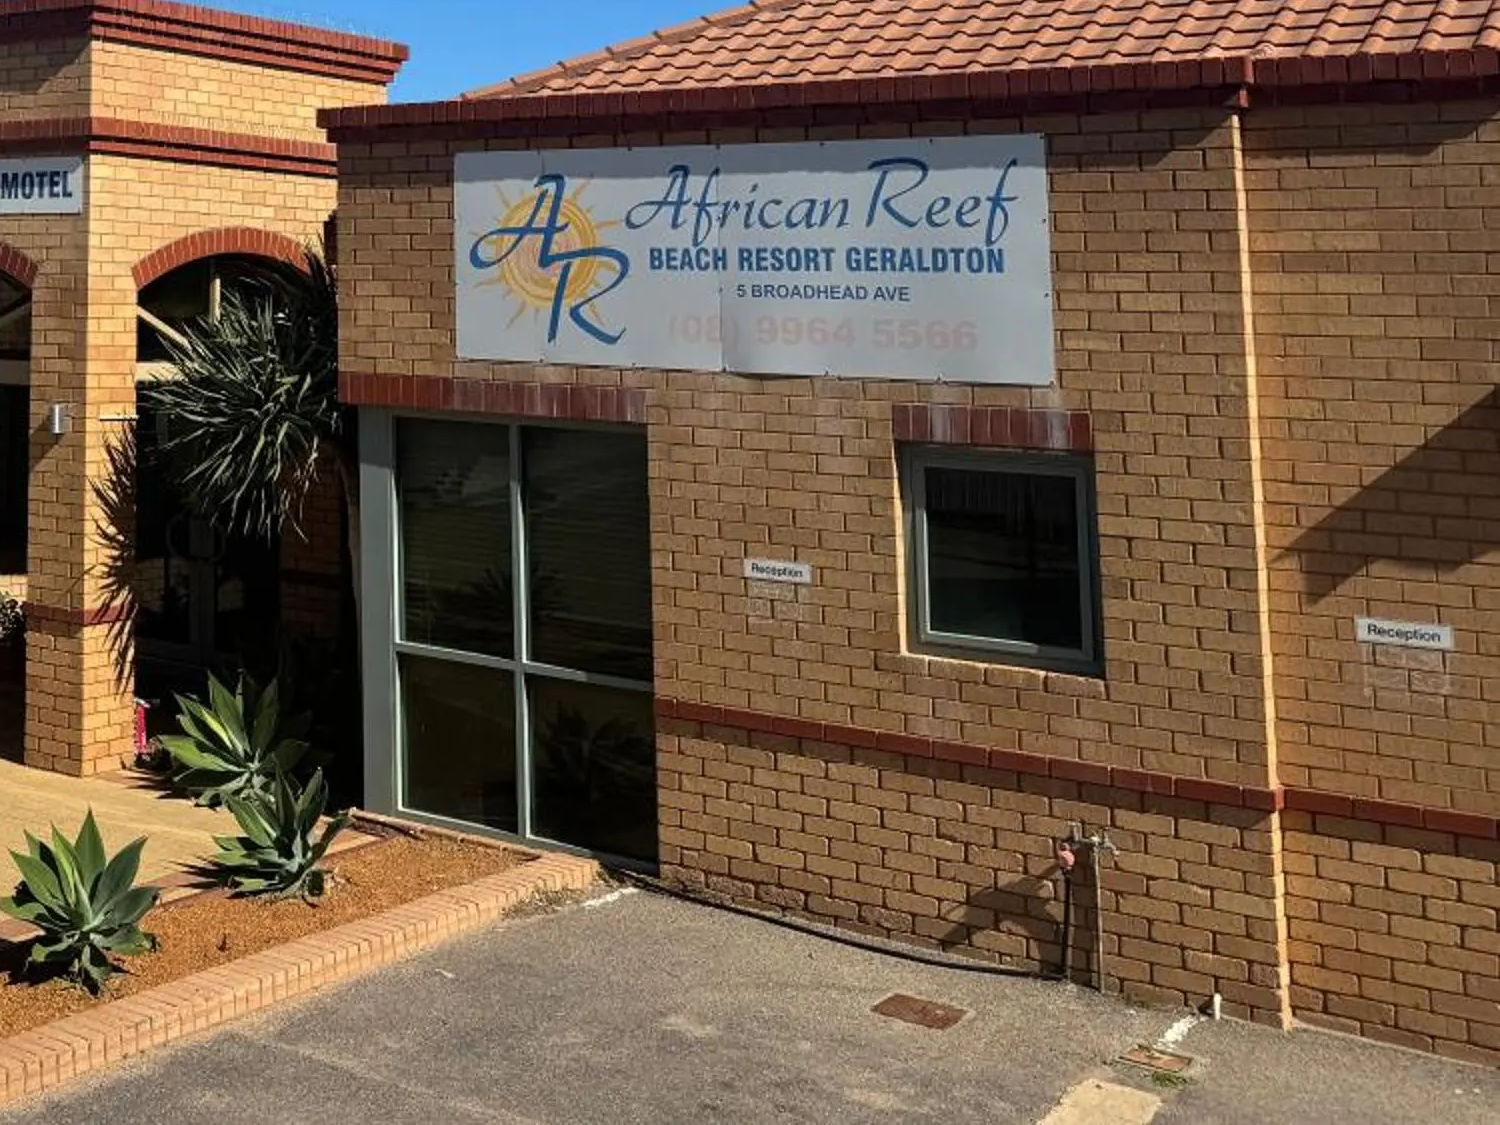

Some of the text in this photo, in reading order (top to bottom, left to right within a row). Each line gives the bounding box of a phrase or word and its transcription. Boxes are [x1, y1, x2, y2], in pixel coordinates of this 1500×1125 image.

[0, 170, 73, 200] MOTEL
[624, 156, 1020, 246] African Reef
[649, 246, 1005, 274] BEACH RESORT GERALDTON
[736, 283, 911, 302] 5 BROADHEAD AVE
[756, 315, 856, 348] 9964
[871, 318, 978, 351] 5566
[751, 562, 803, 577] Reception
[1367, 623, 1441, 643] Reception
